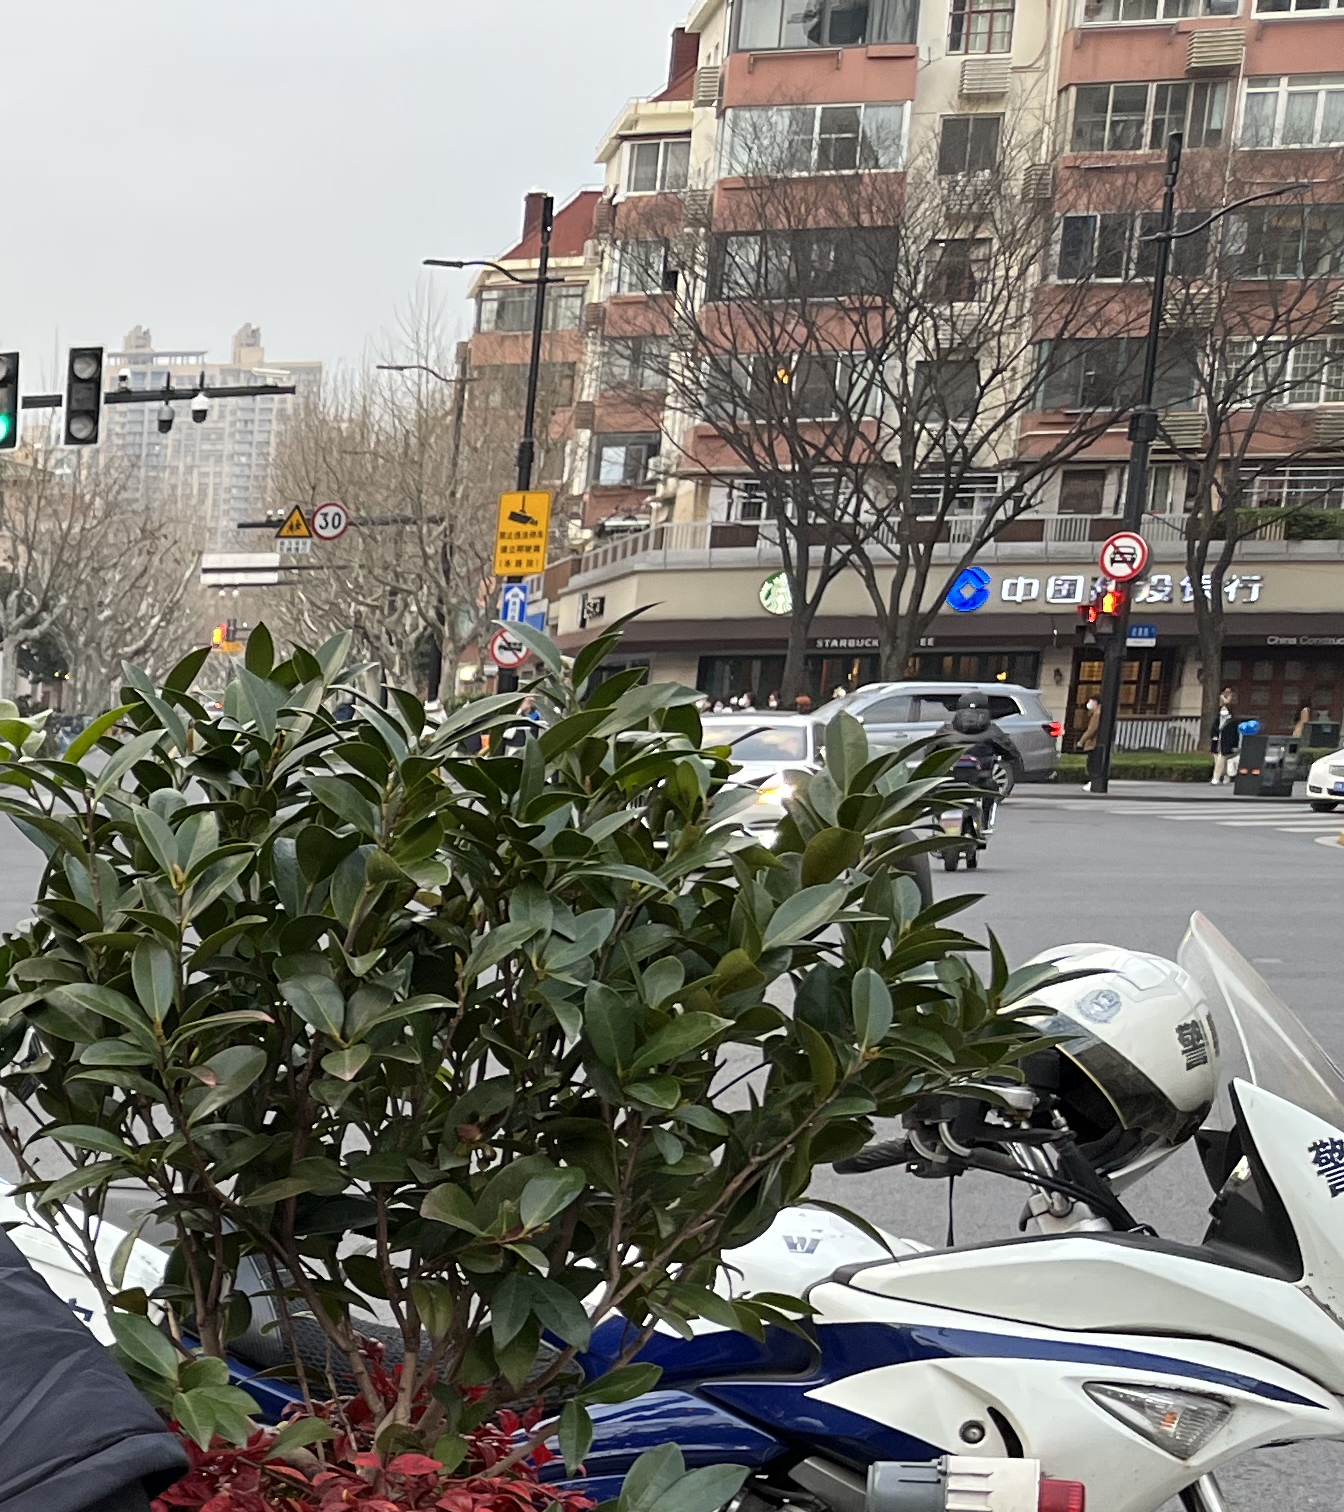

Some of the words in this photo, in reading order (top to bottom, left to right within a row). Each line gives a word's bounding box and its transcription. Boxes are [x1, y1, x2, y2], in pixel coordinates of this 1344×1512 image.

[319, 512, 342, 530] 30
[1001, 574, 1264, 604] 中国设银行
[816, 638, 879, 648] STARBUCK
